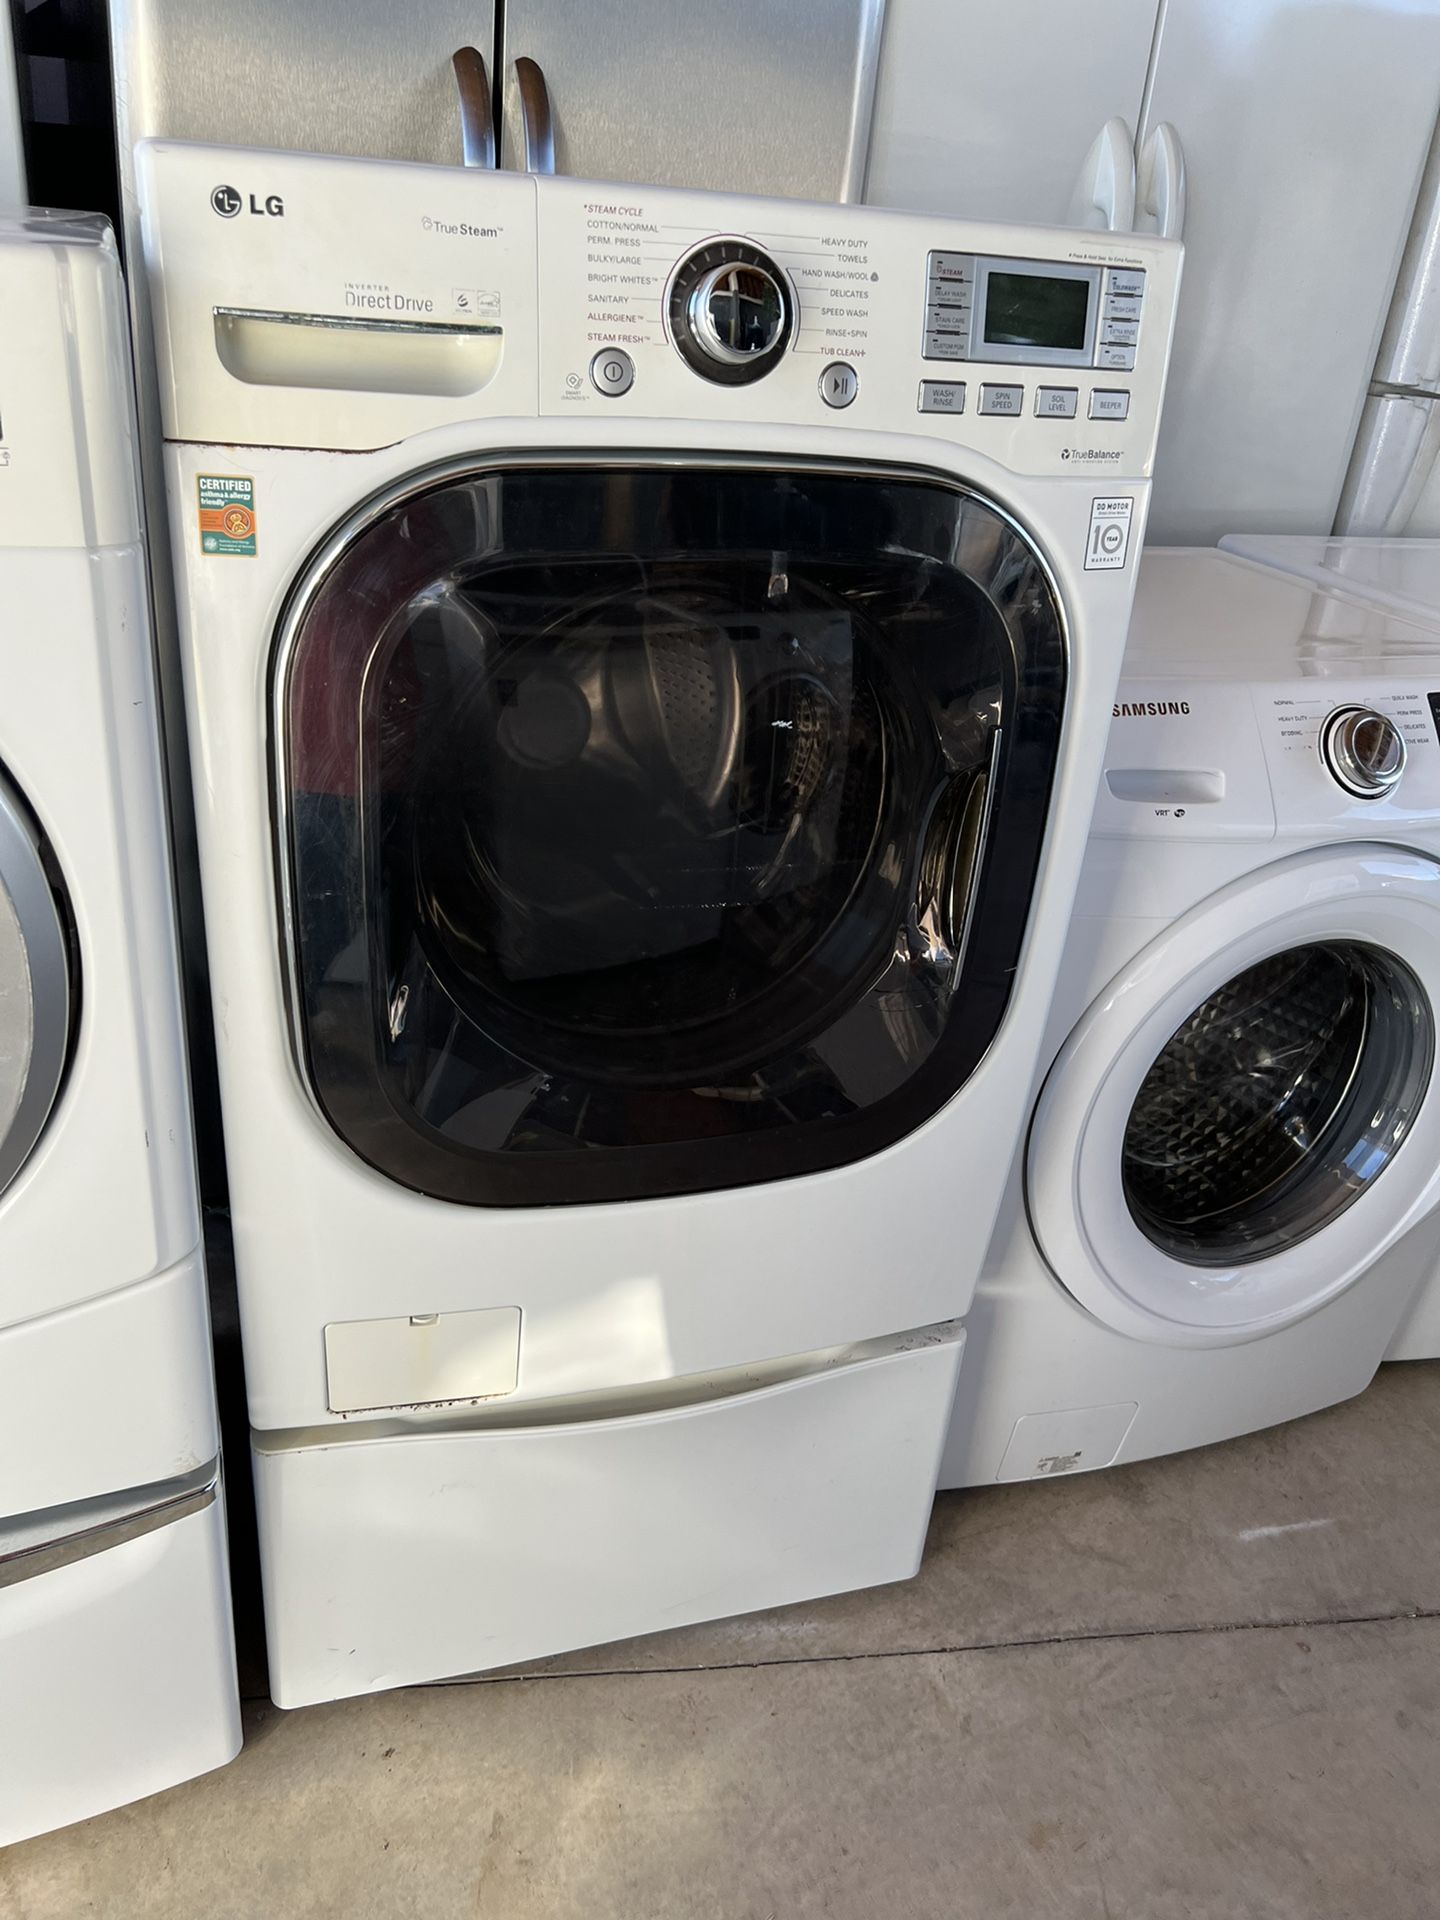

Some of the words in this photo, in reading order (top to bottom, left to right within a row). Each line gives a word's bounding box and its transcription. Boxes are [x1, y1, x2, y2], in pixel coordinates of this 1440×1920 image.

[249, 193, 284, 217] LG
[618, 206, 643, 217] CYCLE
[587, 219, 659, 233] COTTON/NORMAL
[615, 236, 641, 247] PRESS
[822, 237, 846, 247] HEAVY
[848, 239, 868, 248] DUTY
[587, 253, 641, 265] BULKY/LARGE
[838, 254, 868, 264] TOWELS
[587, 273, 618, 283] BRIGHT
[802, 268, 823, 278] HAND
[824, 269, 869, 281] WASH/WOOL
[345, 283, 390, 291] INVERTER
[587, 294, 630, 305] SANITARY
[830, 289, 869, 299] DELICATES
[345, 290, 392, 309] Direct
[394, 294, 434, 313] Drive
[821, 307, 845, 317] SPEED
[846, 309, 869, 318] WASH
[587, 332, 616, 343] STEAM
[820, 347, 836, 356] TUB
[995, 392, 1011, 400] SPIN
[1052, 395, 1065, 403] SOIL
[933, 398, 953, 406] RINSE
[991, 400, 1012, 409] SPEED
[1048, 403, 1066, 412] LEVEL
[1100, 401, 1122, 409] BEEPER
[200, 479, 252, 492] CERTIFIED
[1092, 524, 1124, 555] 10
[1112, 701, 1190, 717] SAMSUNG
